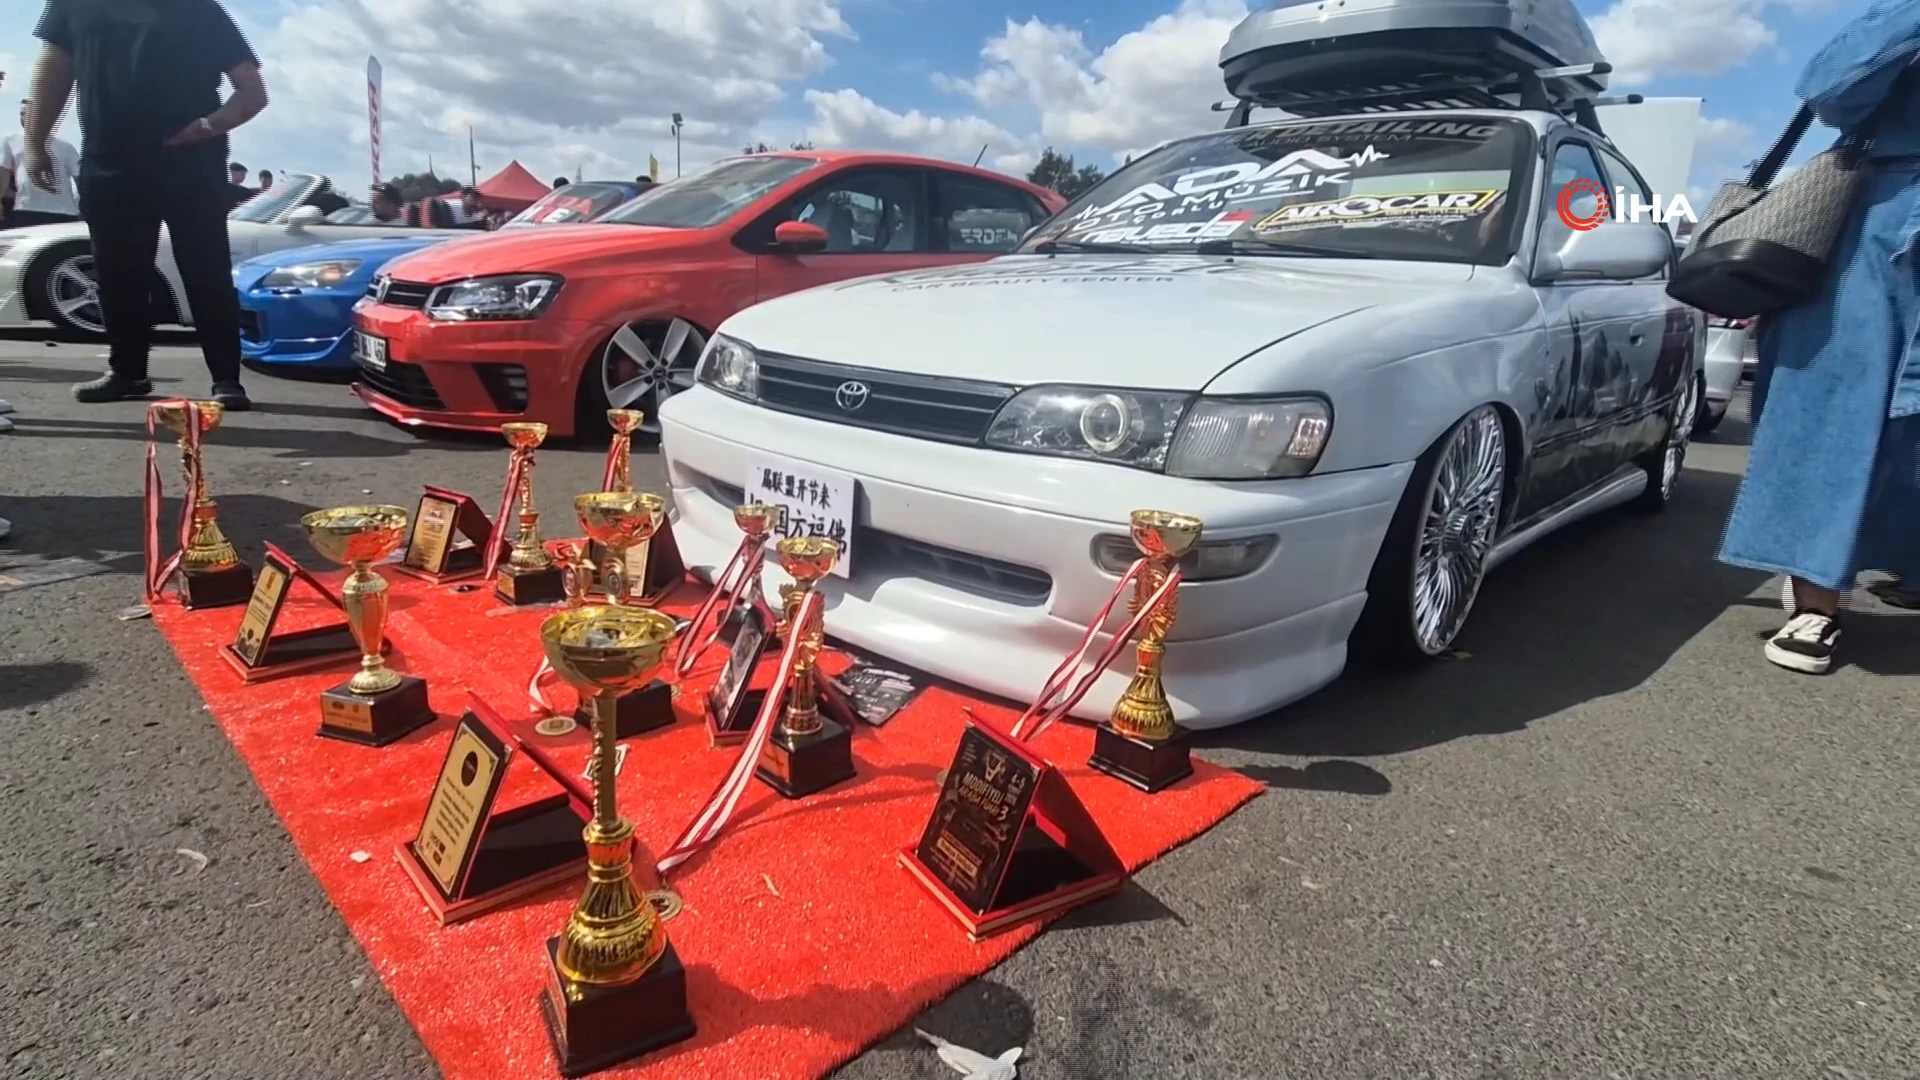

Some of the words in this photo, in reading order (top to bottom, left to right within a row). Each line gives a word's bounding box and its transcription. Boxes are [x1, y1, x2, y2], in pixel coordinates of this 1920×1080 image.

[1276, 120, 1501, 138] DETAILING
[1072, 201, 1165, 231] OTO
[1061, 275, 1175, 284] CENTER
